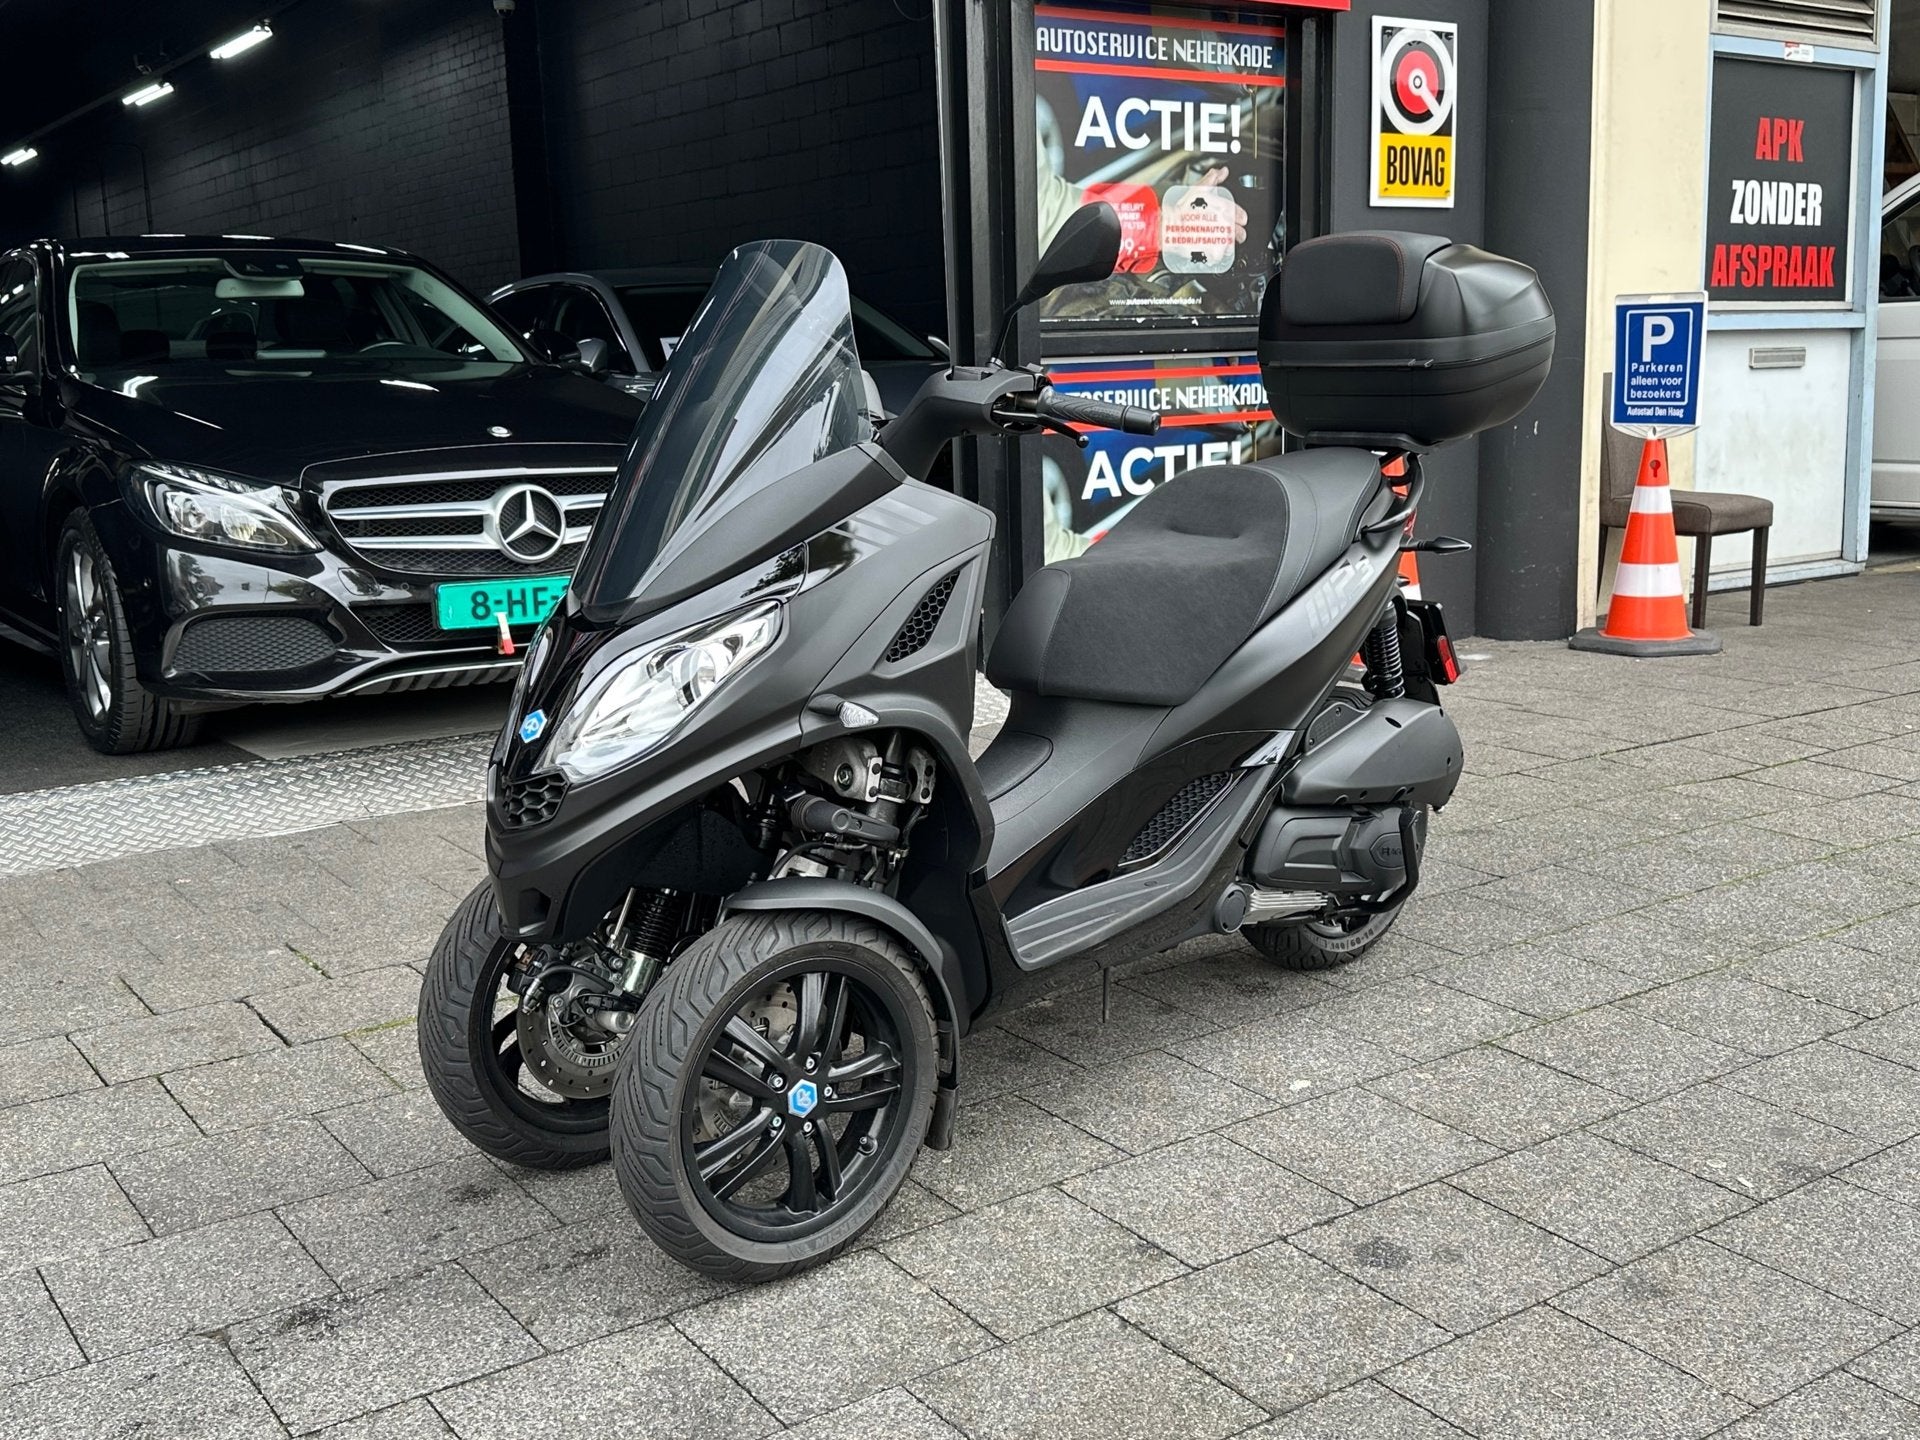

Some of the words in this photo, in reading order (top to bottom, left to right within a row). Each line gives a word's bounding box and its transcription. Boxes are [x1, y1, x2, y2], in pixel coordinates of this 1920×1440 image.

[1036, 27, 1168, 61] AUTOSERVICE
[1173, 38, 1272, 68] NEHERKADE
[1074, 96, 1241, 154] ACTIE!
[1755, 117, 1805, 162] APK
[1386, 145, 1446, 187] BOVAG
[1729, 180, 1822, 226] ZONDER
[1165, 225, 1232, 233] PERSONENAUTO'S
[1181, 213, 1200, 221] VOOR
[1201, 213, 1217, 222] ALLE
[1164, 236, 1170, 244] &
[1171, 236, 1233, 245] BEDRIJFSAUTO'S
[1710, 244, 1836, 288] AFSPRAAK
[1642, 316, 1675, 362] P
[1631, 363, 1683, 373] Parkeren
[1631, 376, 1658, 386] alleen
[1661, 377, 1683, 386] voor
[1064, 387, 1172, 411] ERVICE
[1630, 389, 1682, 399] bezoekers
[1627, 407, 1654, 416] Autostad
[1655, 407, 1667, 416] Den
[1668, 407, 1684, 418] Haag
